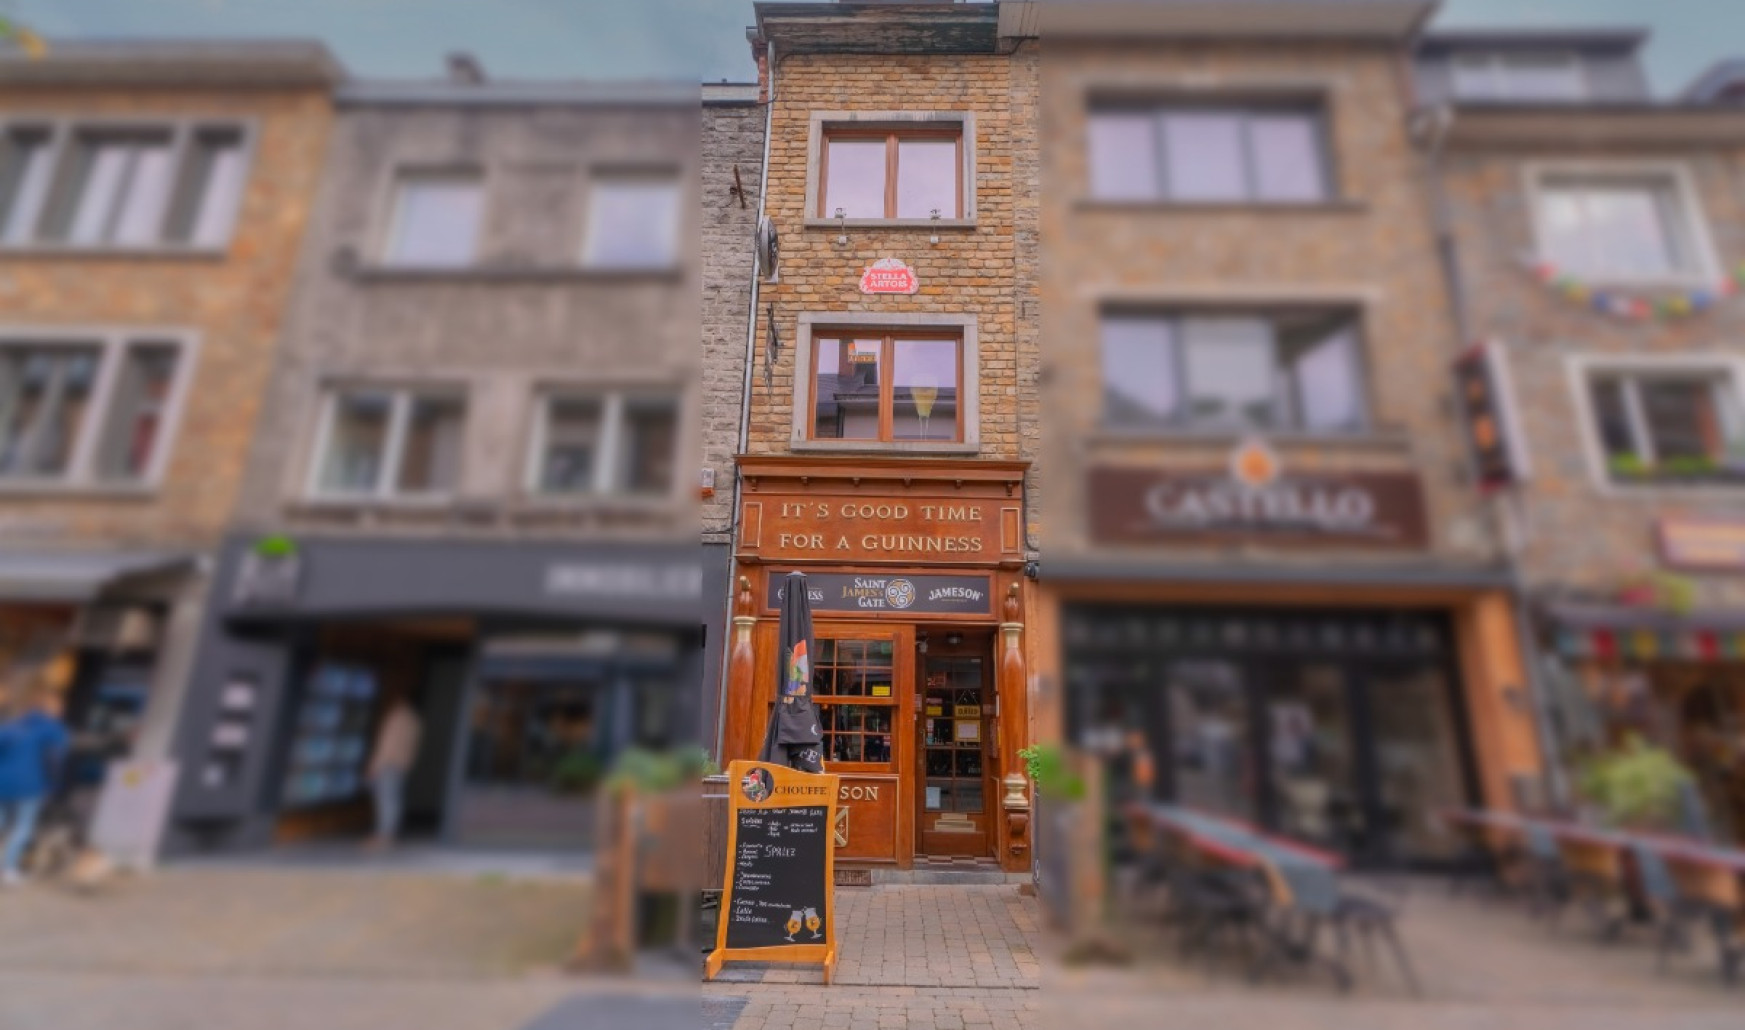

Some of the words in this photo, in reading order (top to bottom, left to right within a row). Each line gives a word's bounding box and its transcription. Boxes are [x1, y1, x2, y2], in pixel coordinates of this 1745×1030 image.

[870, 280, 908, 288] ARTOIS
[841, 504, 909, 520] GOOD
[922, 505, 982, 520] TIME
[780, 533, 825, 548] FOR
[837, 535, 850, 549] A
[861, 536, 982, 552] GUINNESS
[854, 577, 887, 589] SAINT
[928, 587, 979, 601] JAMESON
[858, 597, 886, 608] GATE
[774, 786, 827, 796] CHOUFFE
